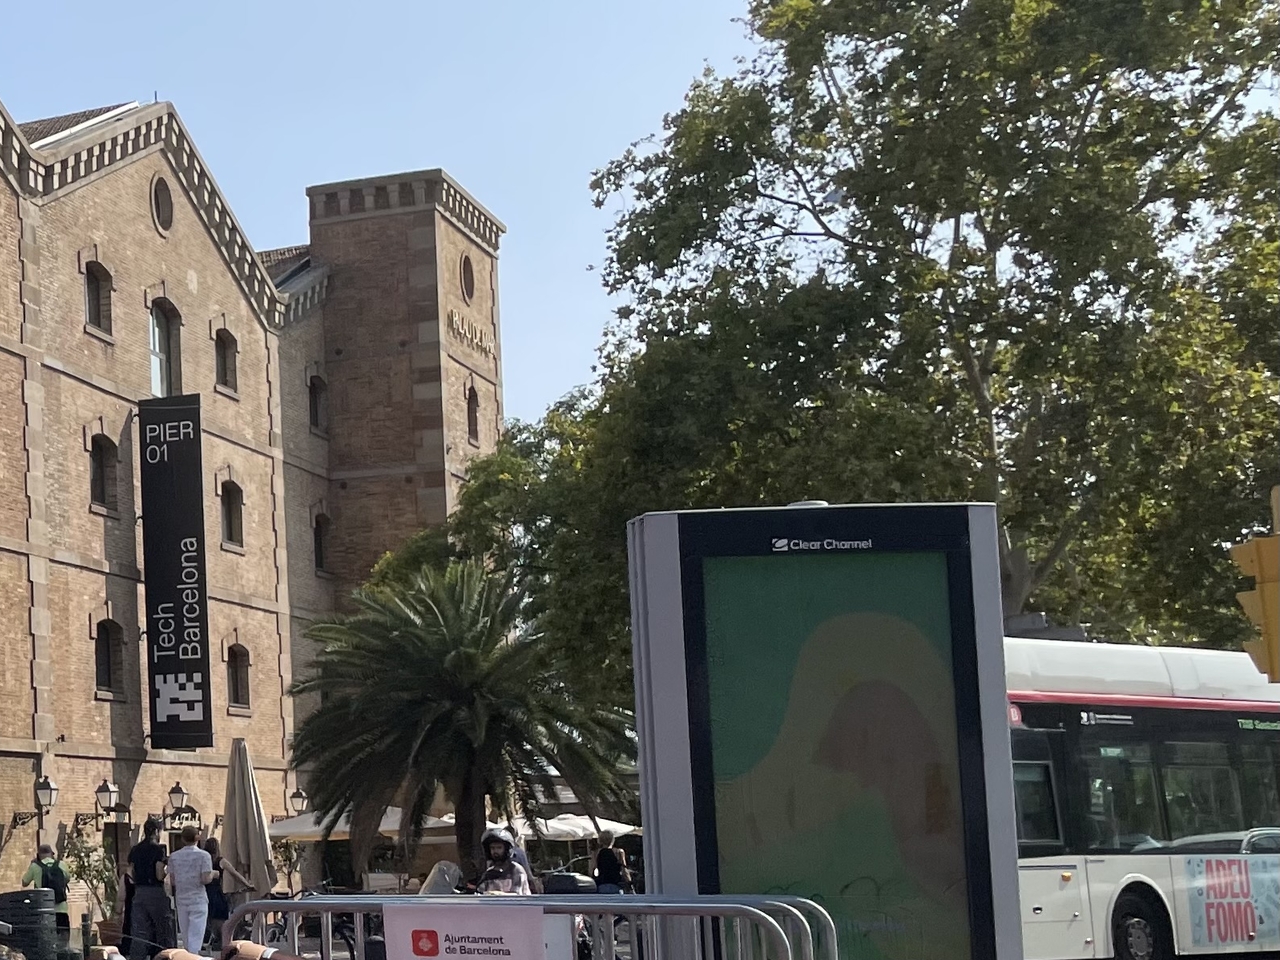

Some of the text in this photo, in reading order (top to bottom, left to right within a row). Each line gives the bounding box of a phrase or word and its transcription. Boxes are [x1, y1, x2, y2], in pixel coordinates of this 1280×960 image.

[146, 421, 193, 443] PIER
[146, 444, 168, 464] 01
[790, 538, 873, 550] Clear Channel
[176, 537, 201, 660] Barcelona
[152, 603, 176, 663] Tech
[1205, 859, 1251, 900] ADEU
[1204, 900, 1257, 943] FOMO
[443, 934, 504, 945] Ajuntament
[445, 946, 512, 956] de Barcelona
